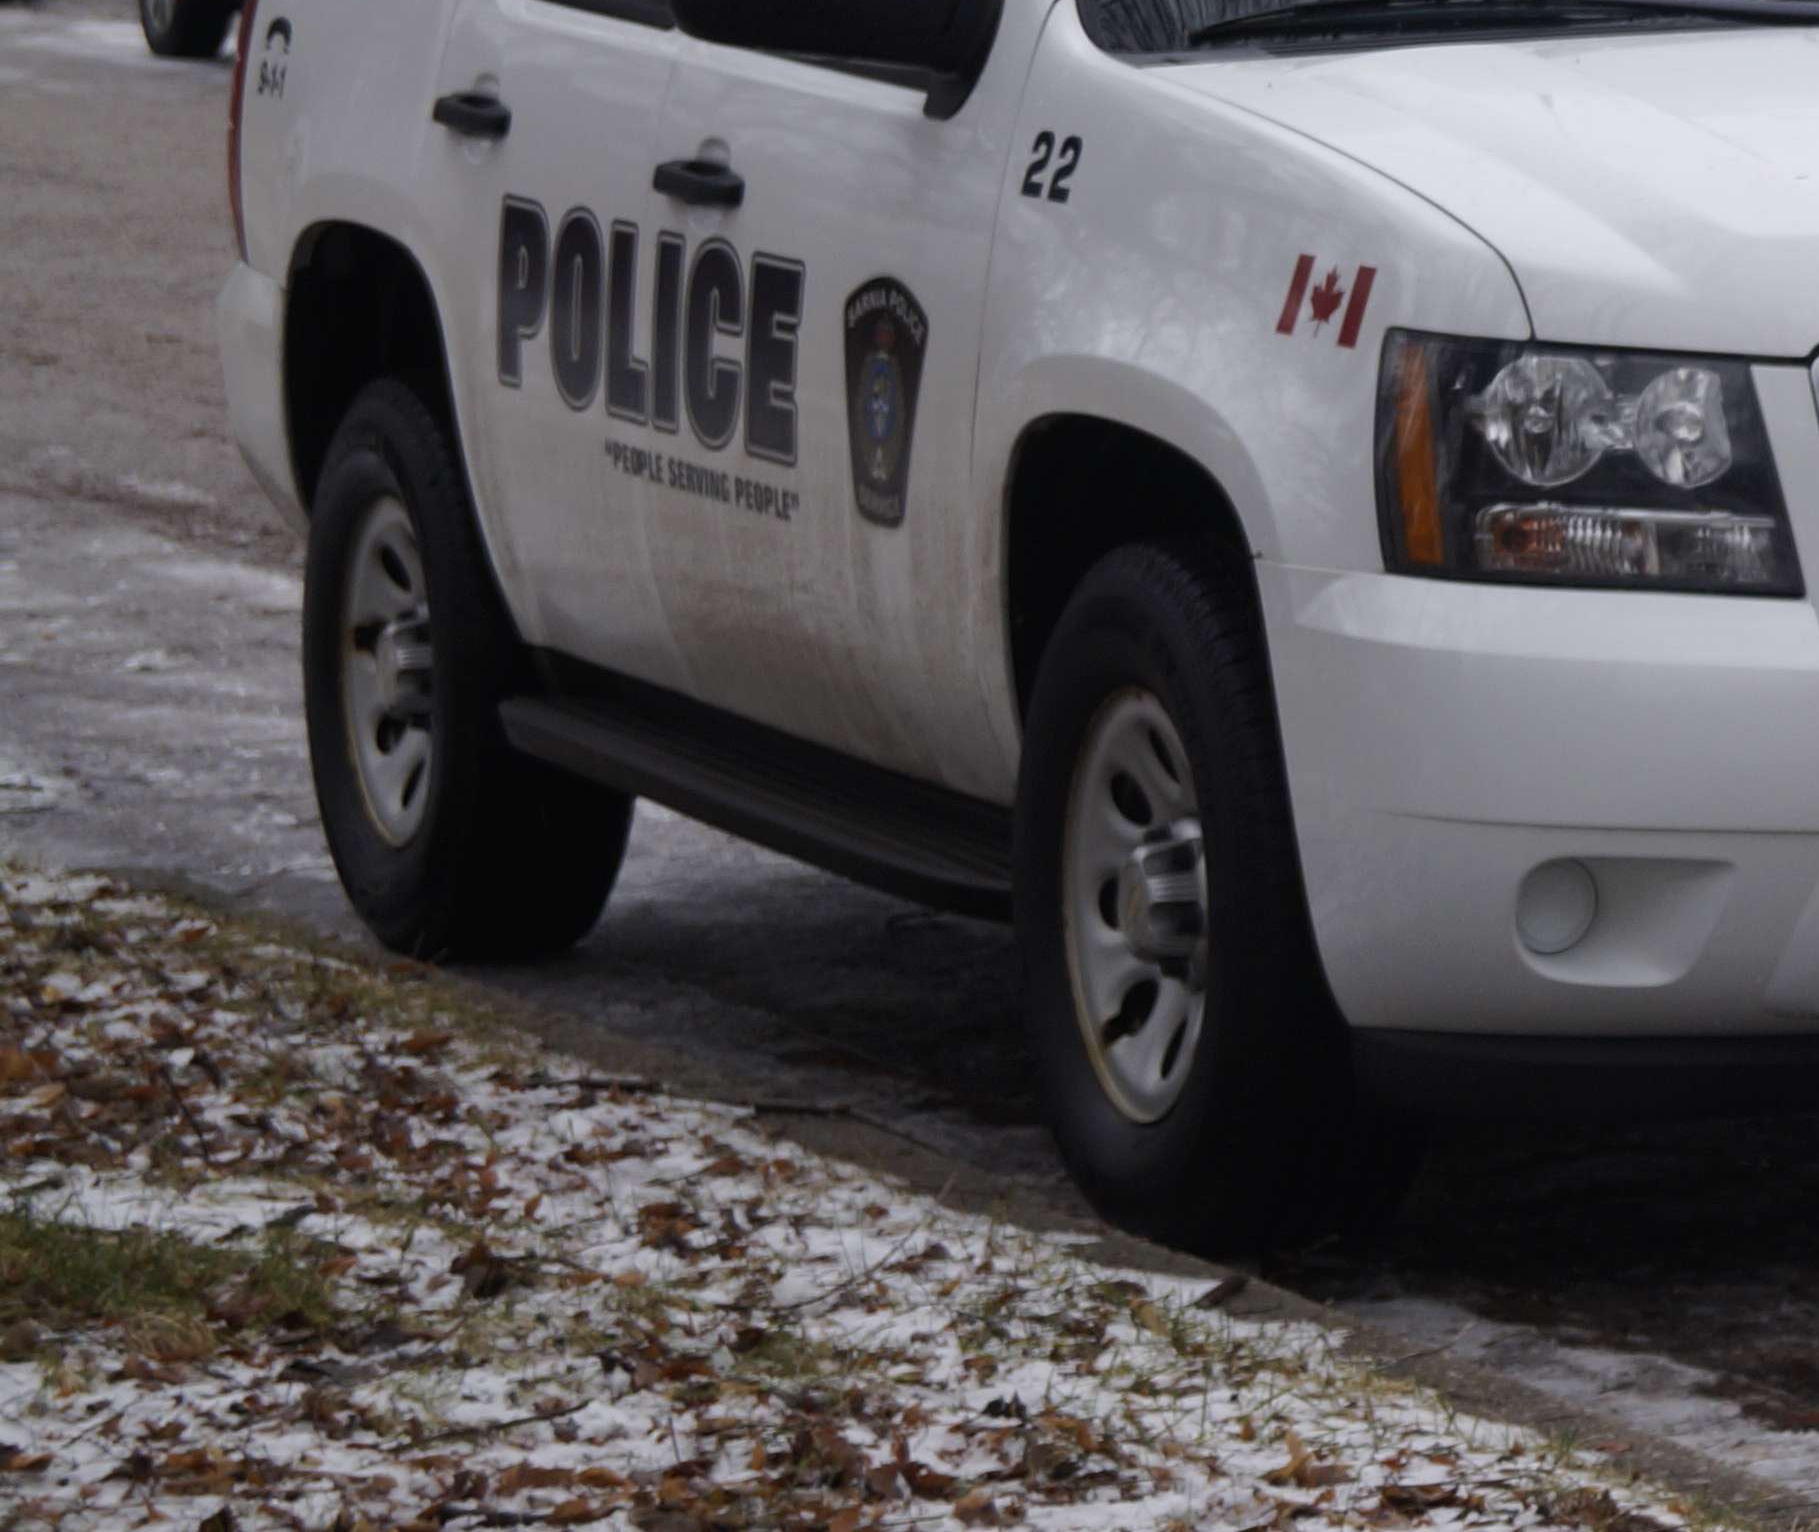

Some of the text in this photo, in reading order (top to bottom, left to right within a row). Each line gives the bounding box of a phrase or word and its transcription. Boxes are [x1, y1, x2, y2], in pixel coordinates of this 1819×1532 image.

[1021, 129, 1083, 204] 22
[498, 193, 806, 467] POLICE
[667, 456, 730, 504] SERVING
